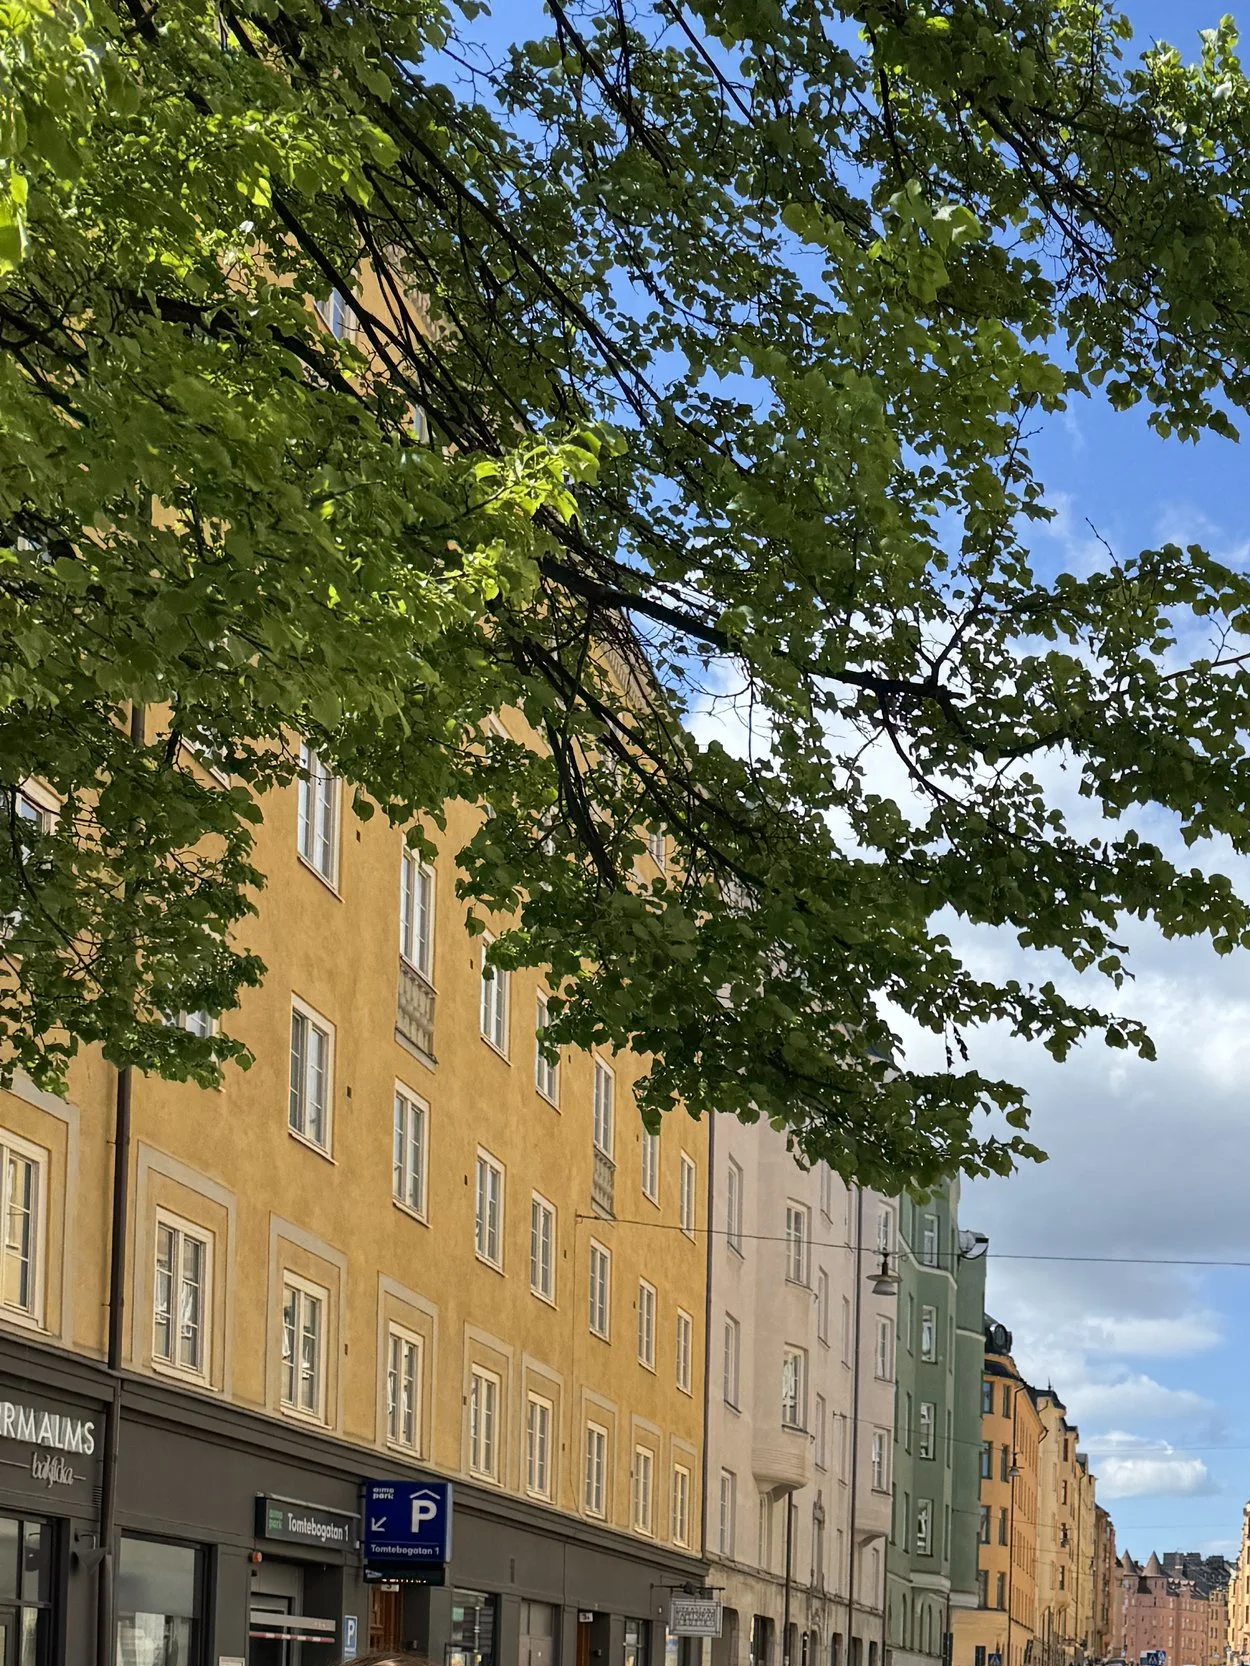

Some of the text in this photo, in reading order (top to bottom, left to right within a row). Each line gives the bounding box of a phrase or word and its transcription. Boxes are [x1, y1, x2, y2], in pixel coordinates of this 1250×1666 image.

[0, 1402, 95, 1455] RMALMS
[287, 1512, 350, 1542] Tomtebogatan 1
[411, 1499, 438, 1533] P
[370, 1544, 433, 1556] Tomtebogatan
[346, 1619, 355, 1646] P
